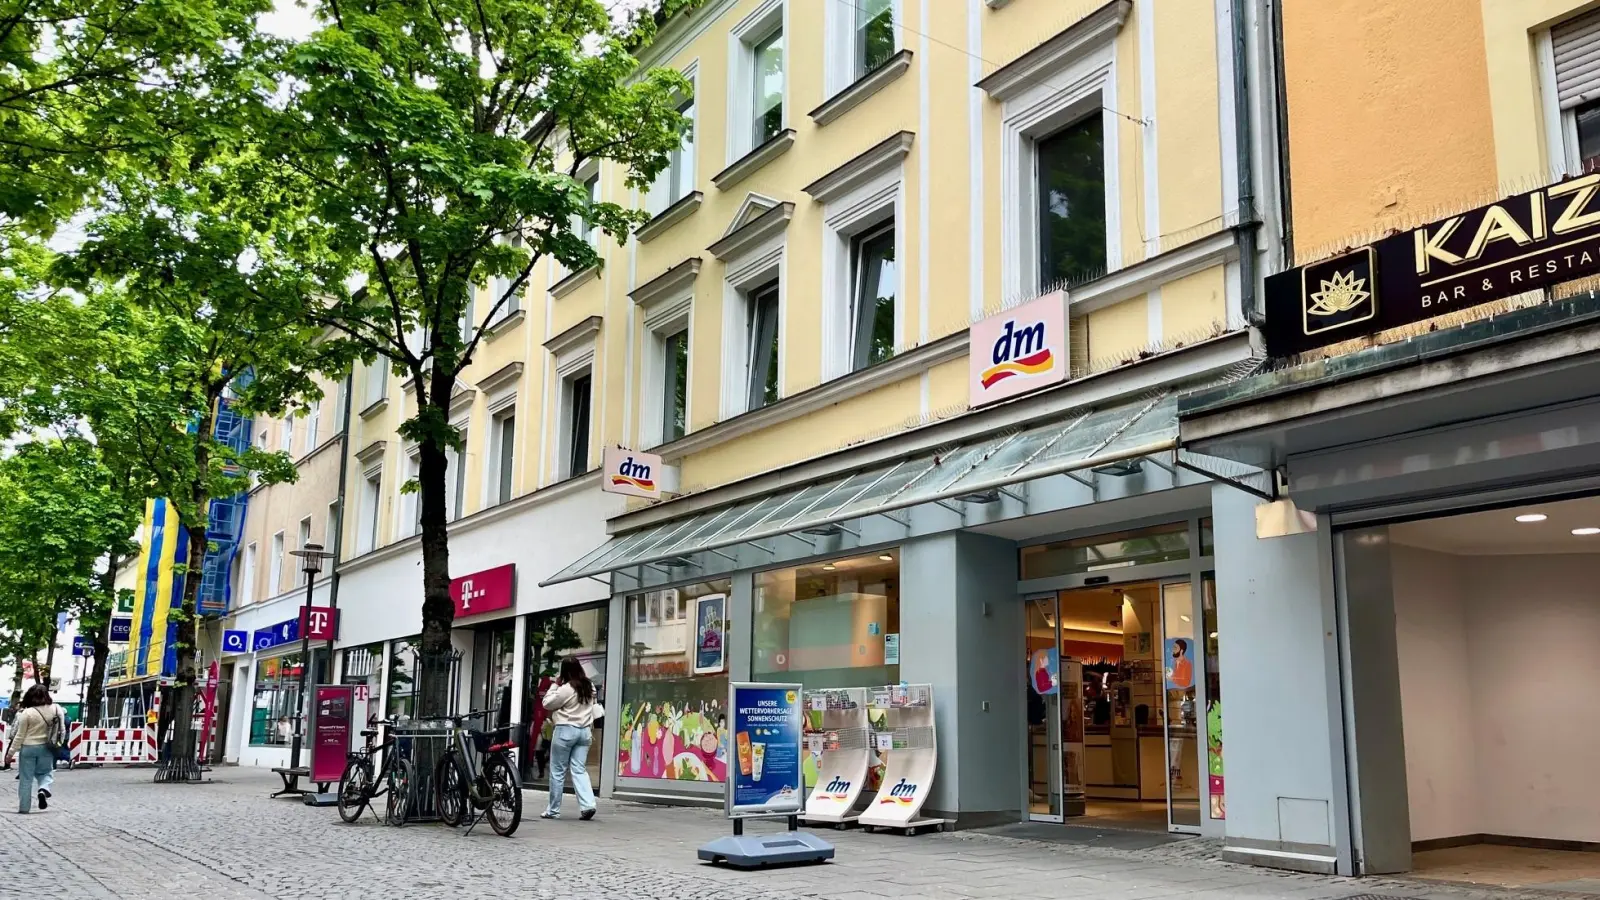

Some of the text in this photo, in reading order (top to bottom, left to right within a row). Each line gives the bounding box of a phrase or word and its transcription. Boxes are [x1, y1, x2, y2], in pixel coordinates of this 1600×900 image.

[1414, 173, 1600, 276] KAIZ
[1421, 248, 1600, 308] BAR & RESTA
[993, 320, 1044, 365] dm
[619, 456, 651, 480] dm
[309, 611, 328, 634] T
[739, 707, 792, 715] WETTERVORHERSAGE
[825, 775, 851, 793] dm
[890, 777, 917, 797] dm
